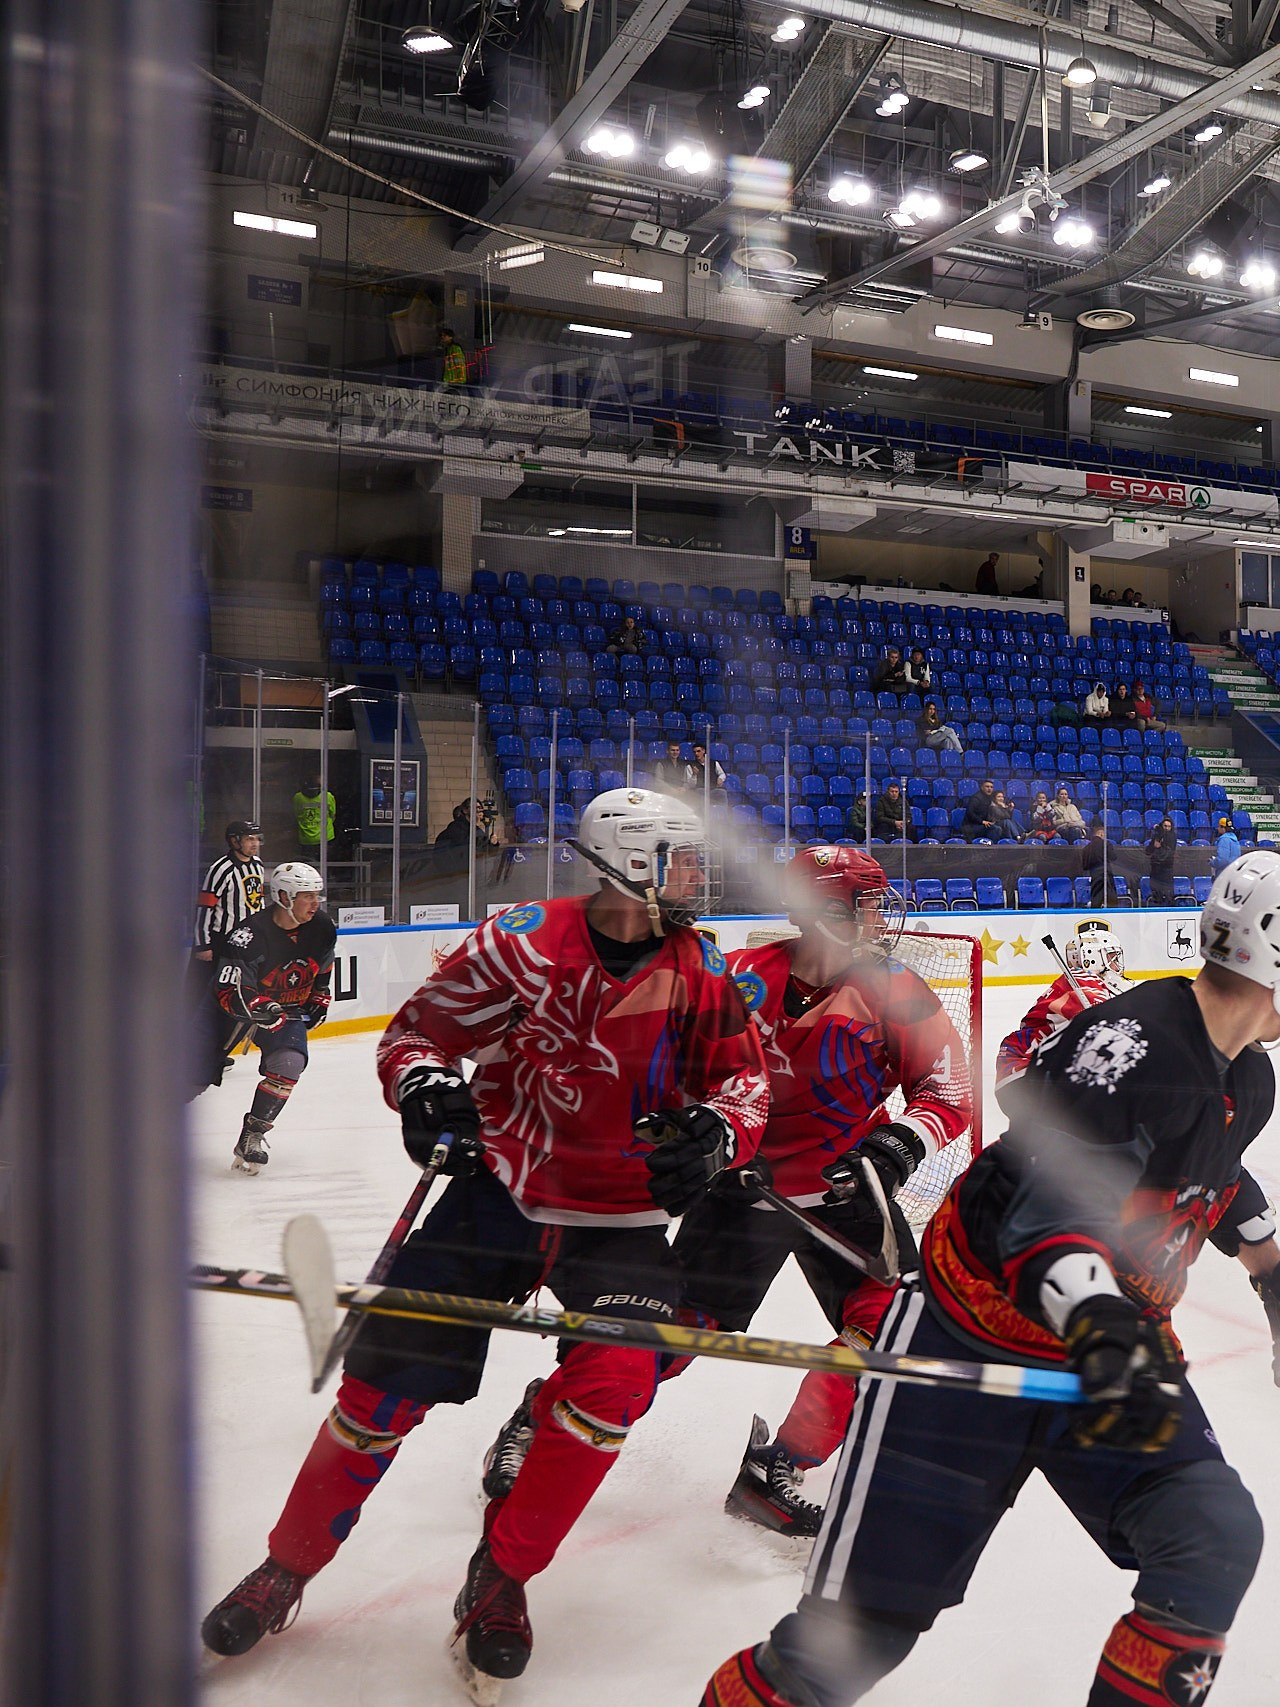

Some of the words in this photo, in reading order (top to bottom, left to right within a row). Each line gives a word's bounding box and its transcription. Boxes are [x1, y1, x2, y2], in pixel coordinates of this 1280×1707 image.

[696, 262, 709, 272] 10
[235, 376, 362, 406] СИМФОНИЯ
[372, 393, 472, 416] НИЖНЕГО
[475, 406, 516, 420] ЖИЛОЙ
[517, 412, 569, 426] КОМПЛЕКС
[732, 430, 882, 471] TANK
[1110, 478, 1188, 501] SPAR
[791, 526, 804, 545] 8
[1076, 568, 1083, 578] 1
[1163, 611, 1169, 621] 5
[1222, 777, 1247, 785] SYNERGETIC
[1255, 813, 1280, 821] SYNERGETIC
[592, 1293, 674, 1320] BAUER
[683, 1328, 836, 1364] TACKS
